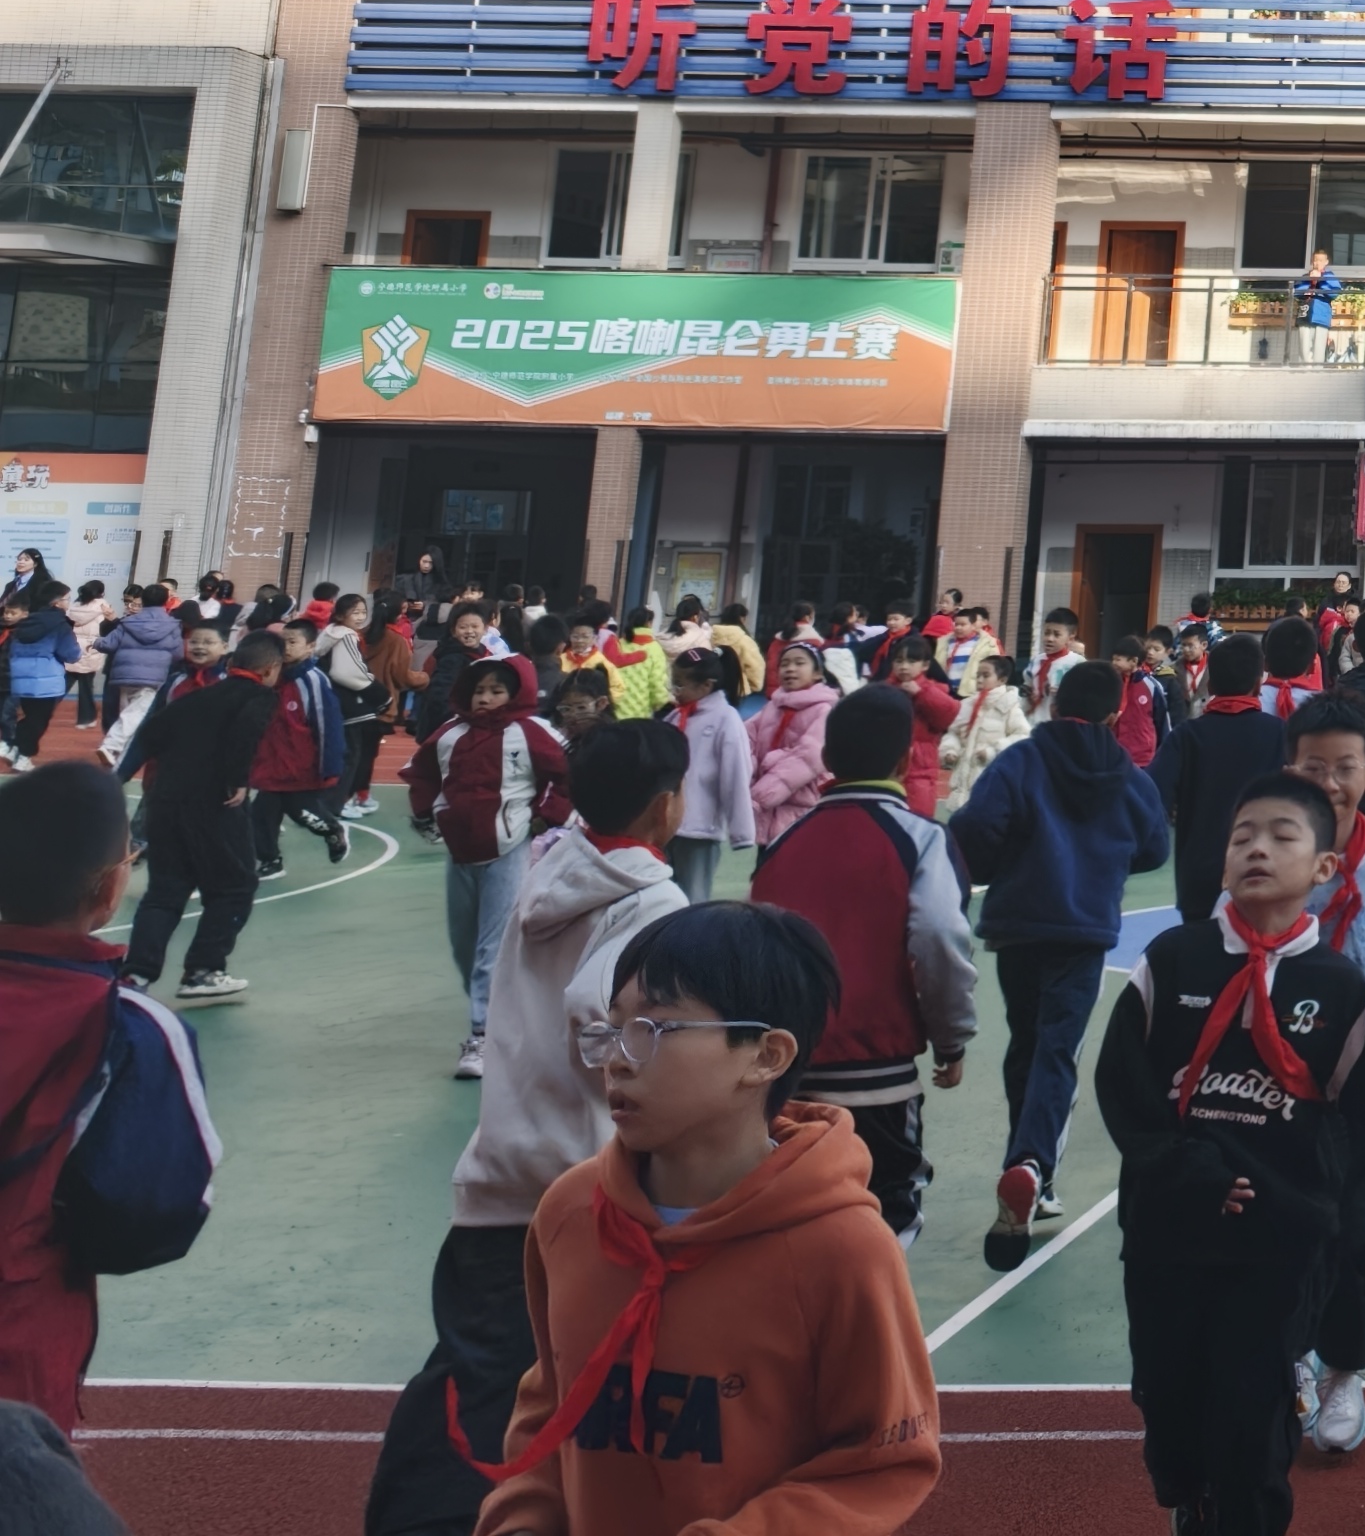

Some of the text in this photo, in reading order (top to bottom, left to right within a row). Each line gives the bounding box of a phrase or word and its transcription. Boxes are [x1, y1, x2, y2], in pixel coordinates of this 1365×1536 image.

[450, 318, 900, 362] 2025喀喇昆仑勇士赛
[1190, 1106, 1267, 1125] XCHENGTONG
